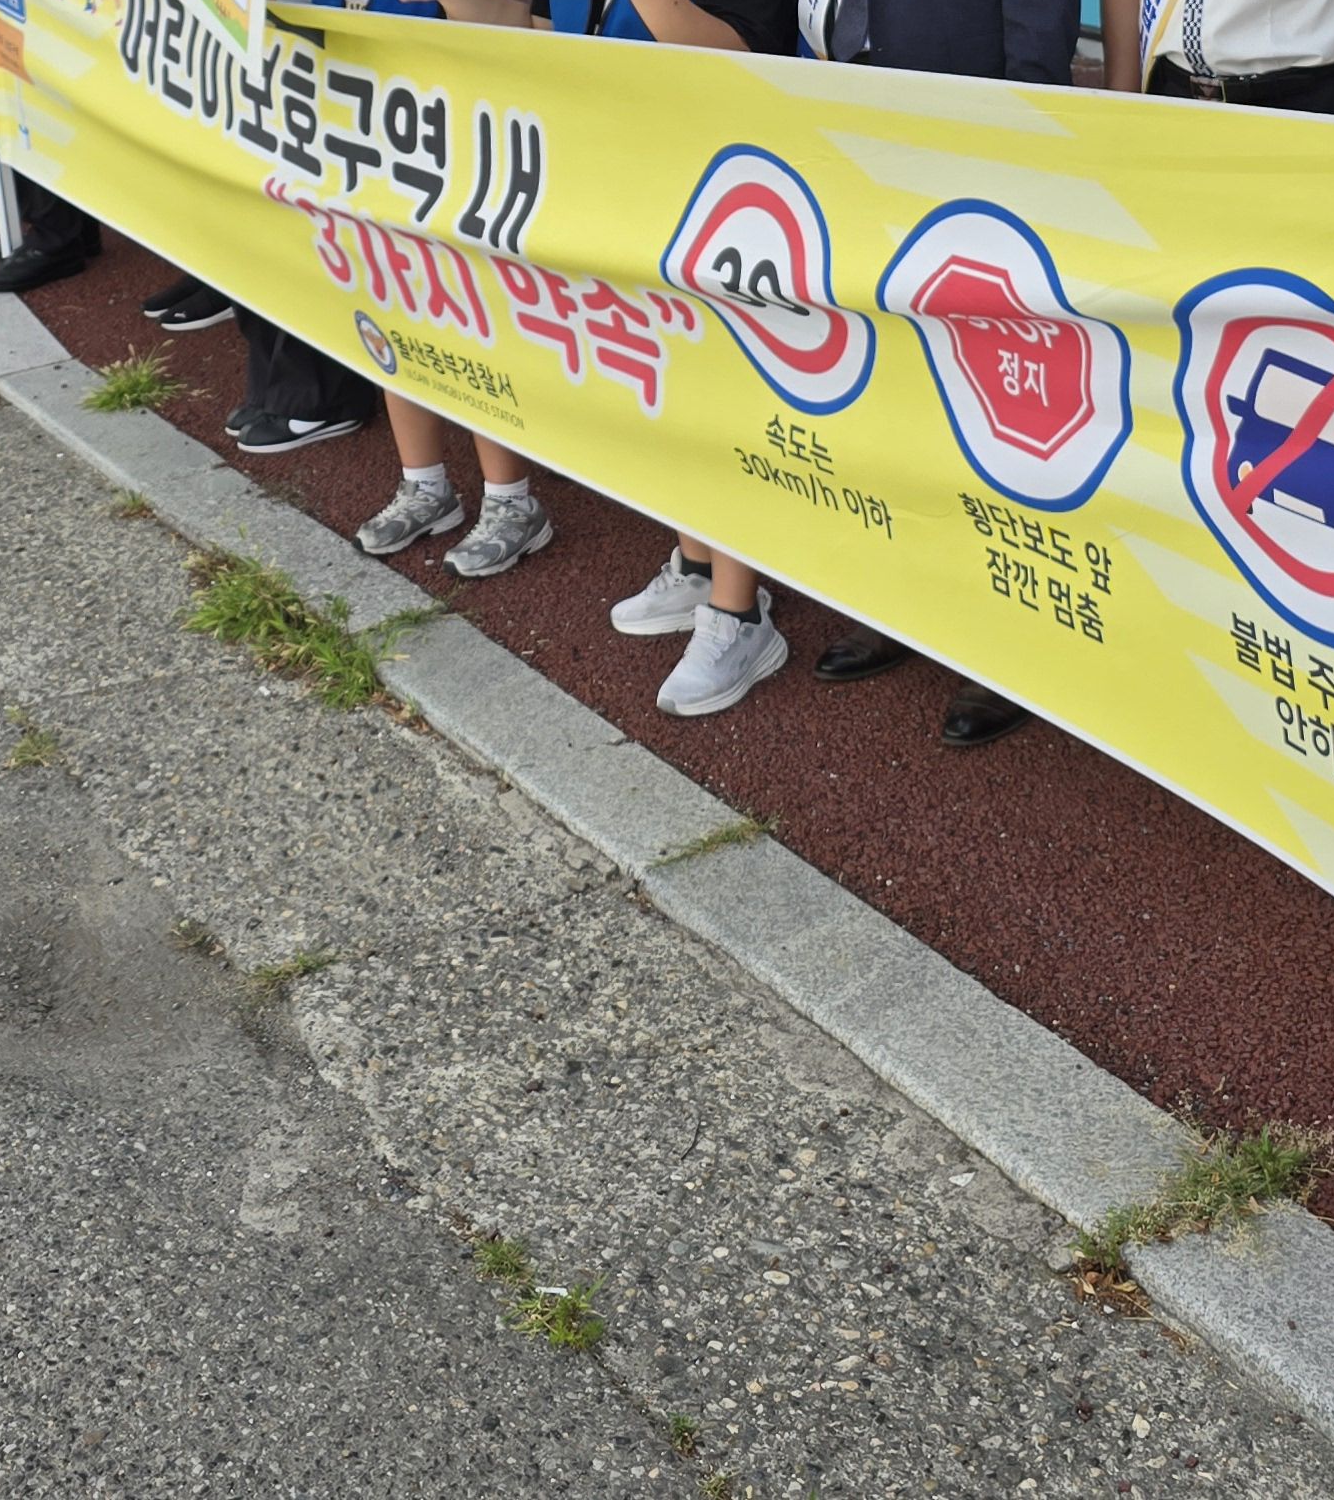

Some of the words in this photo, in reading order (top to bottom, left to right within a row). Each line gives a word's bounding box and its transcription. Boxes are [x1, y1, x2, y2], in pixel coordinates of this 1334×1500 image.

[459, 110, 541, 254] 내
[714, 245, 812, 318] 30
[389, 329, 519, 408] 울산중부경찰서
[996, 348, 1049, 408] 정지
[764, 412, 835, 476] 속도는
[735, 446, 841, 517] 30km/h
[842, 494, 894, 541] 이하
[961, 492, 1078, 576] 횡단보도
[1085, 542, 1114, 597] 앞
[985, 547, 1041, 613] 잠깐
[1048, 581, 1106, 645] 멈춤
[1229, 611, 1297, 693] 불법
